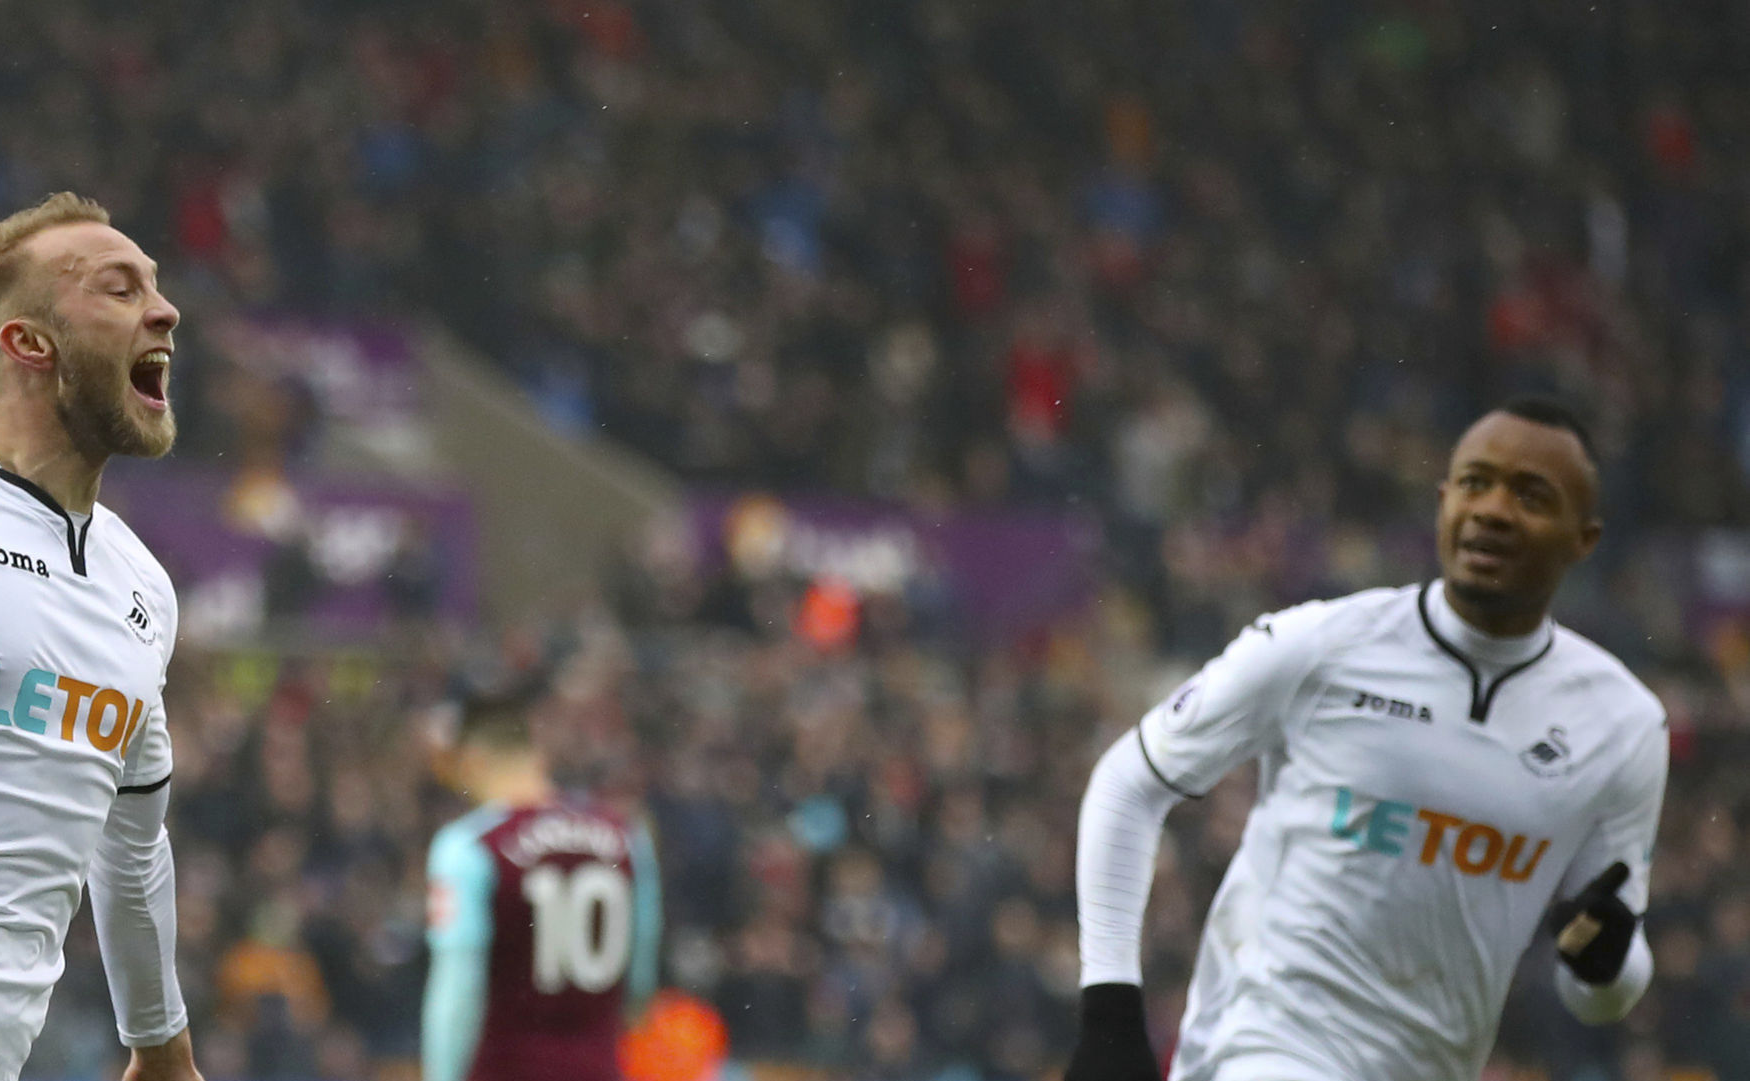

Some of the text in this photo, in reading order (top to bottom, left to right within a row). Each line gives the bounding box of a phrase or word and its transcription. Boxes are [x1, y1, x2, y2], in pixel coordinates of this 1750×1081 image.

[1352, 690, 1434, 726] Joma
[1330, 786, 1552, 884] LETOU
[520, 862, 632, 995] 10
